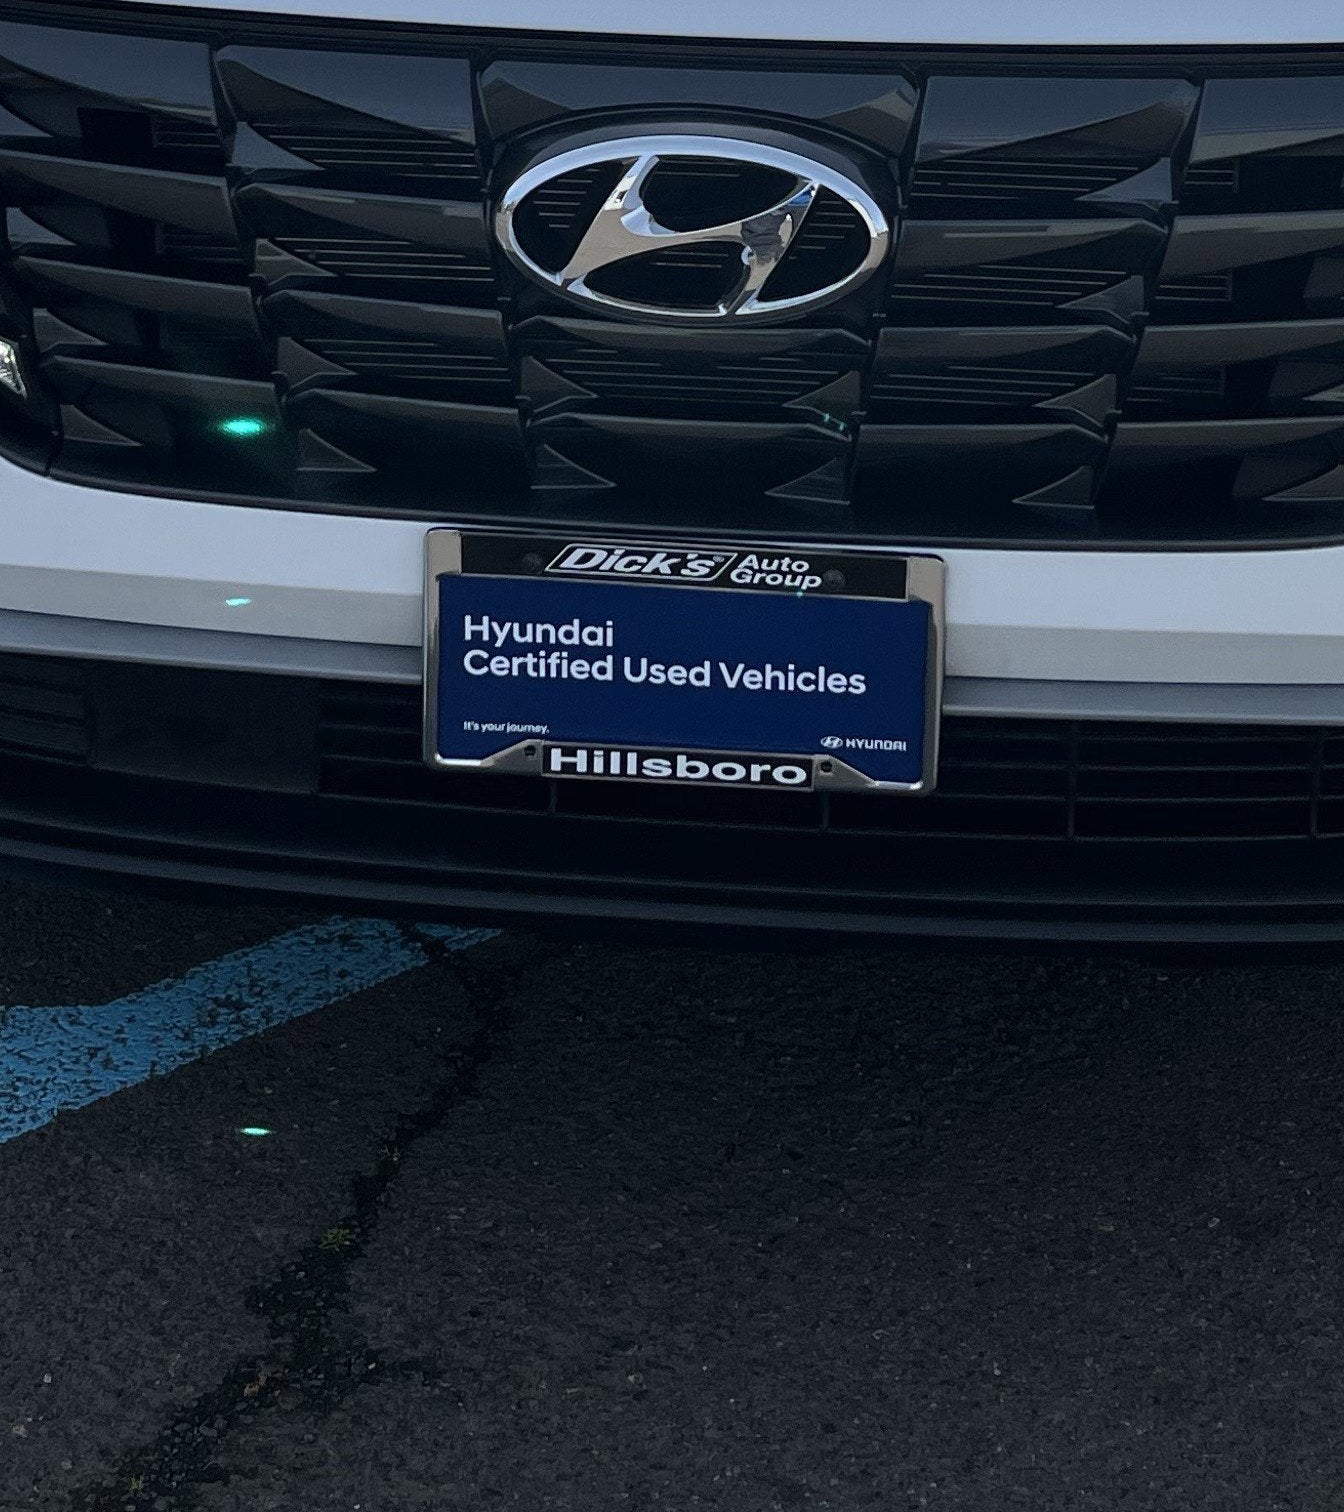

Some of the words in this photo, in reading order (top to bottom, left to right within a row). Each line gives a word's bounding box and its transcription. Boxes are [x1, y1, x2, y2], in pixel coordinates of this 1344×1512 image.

[559, 547, 716, 577] Dick's
[737, 554, 810, 573] Auto
[730, 568, 823, 590] Group
[463, 615, 614, 648] Hyundai
[463, 649, 614, 681] Certified
[622, 657, 711, 688] Used
[719, 662, 867, 694] Vehicles
[463, 720, 480, 731] It's
[481, 722, 506, 733] your
[506, 722, 550, 735] journey.
[845, 738, 907, 752] HYUNDAI
[549, 748, 807, 785] Hillsboro
